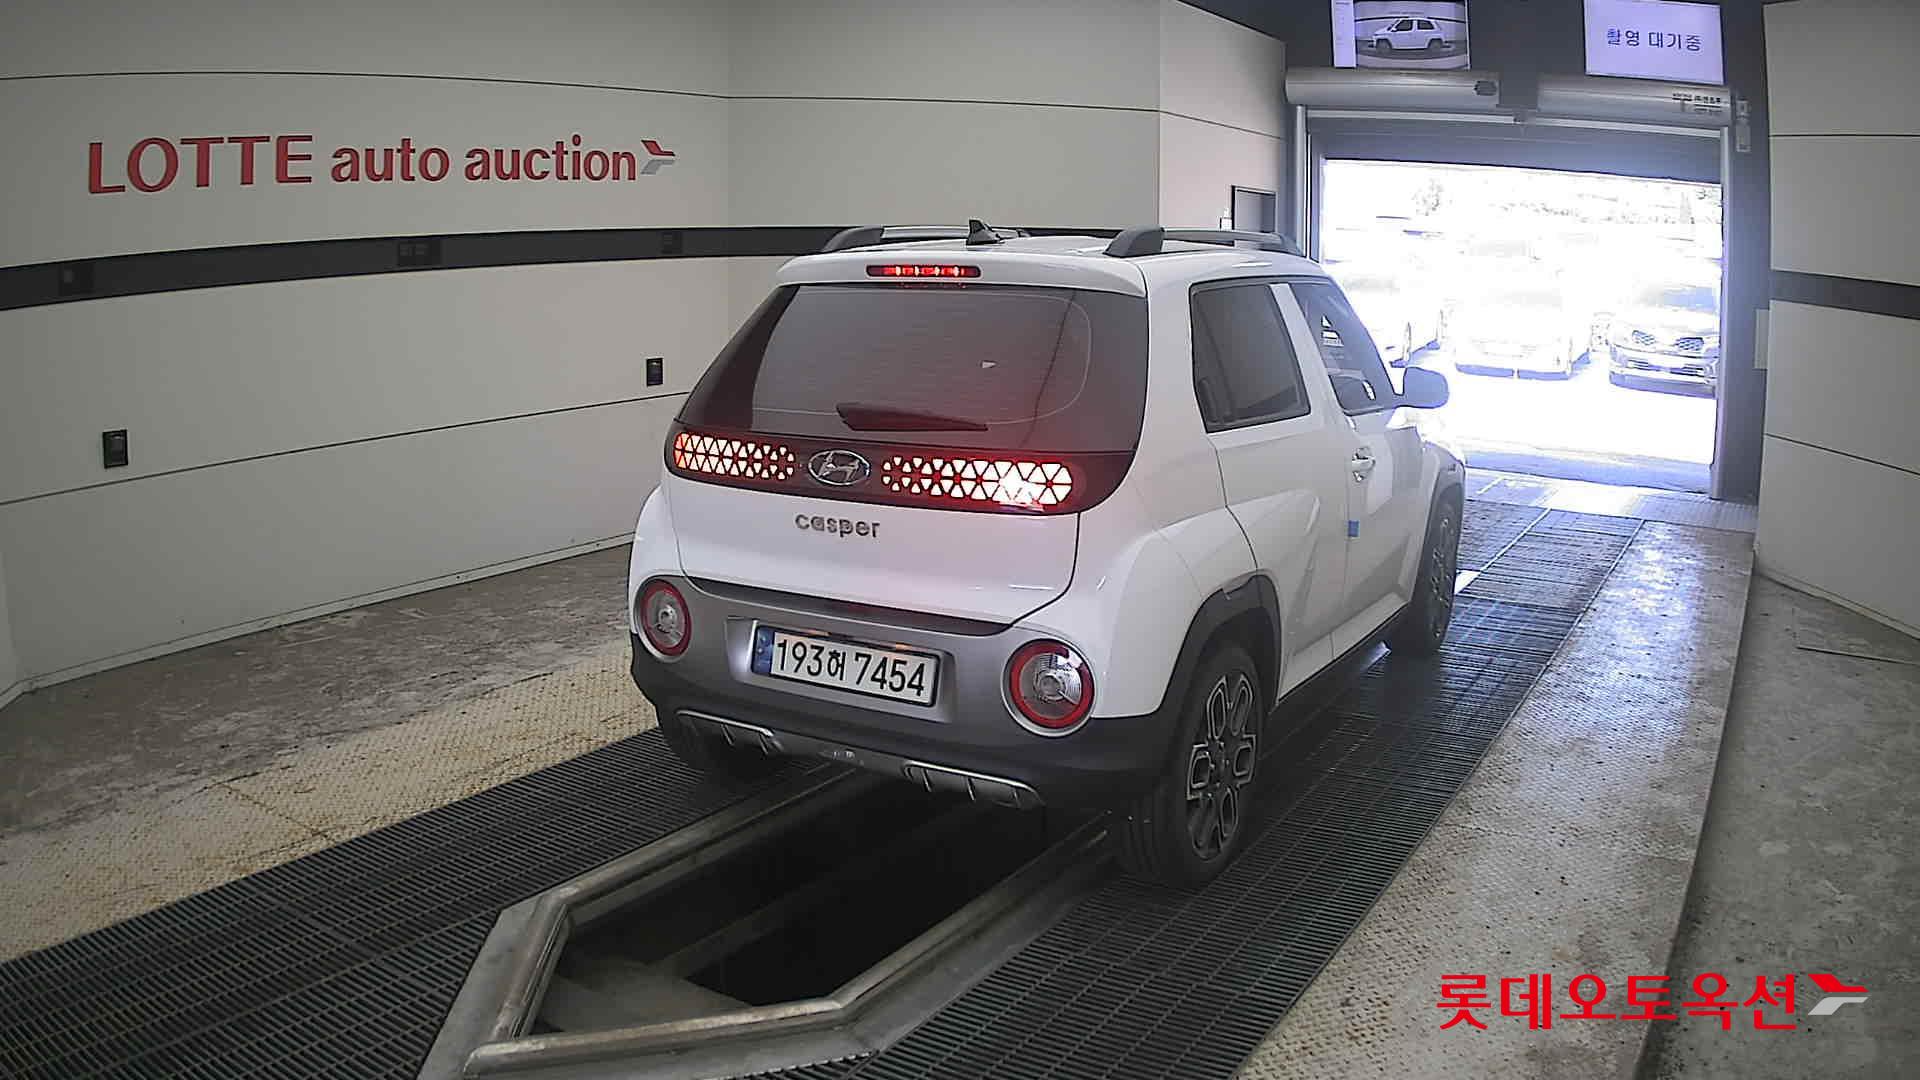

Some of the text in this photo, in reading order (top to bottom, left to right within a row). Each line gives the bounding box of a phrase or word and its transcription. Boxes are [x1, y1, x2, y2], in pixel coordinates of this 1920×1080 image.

[1607, 28, 1701, 52] 촬영 대기중
[88, 134, 638, 194] LOTTE auto auction
[795, 513, 880, 538] casper
[776, 639, 926, 697] 193허 7454
